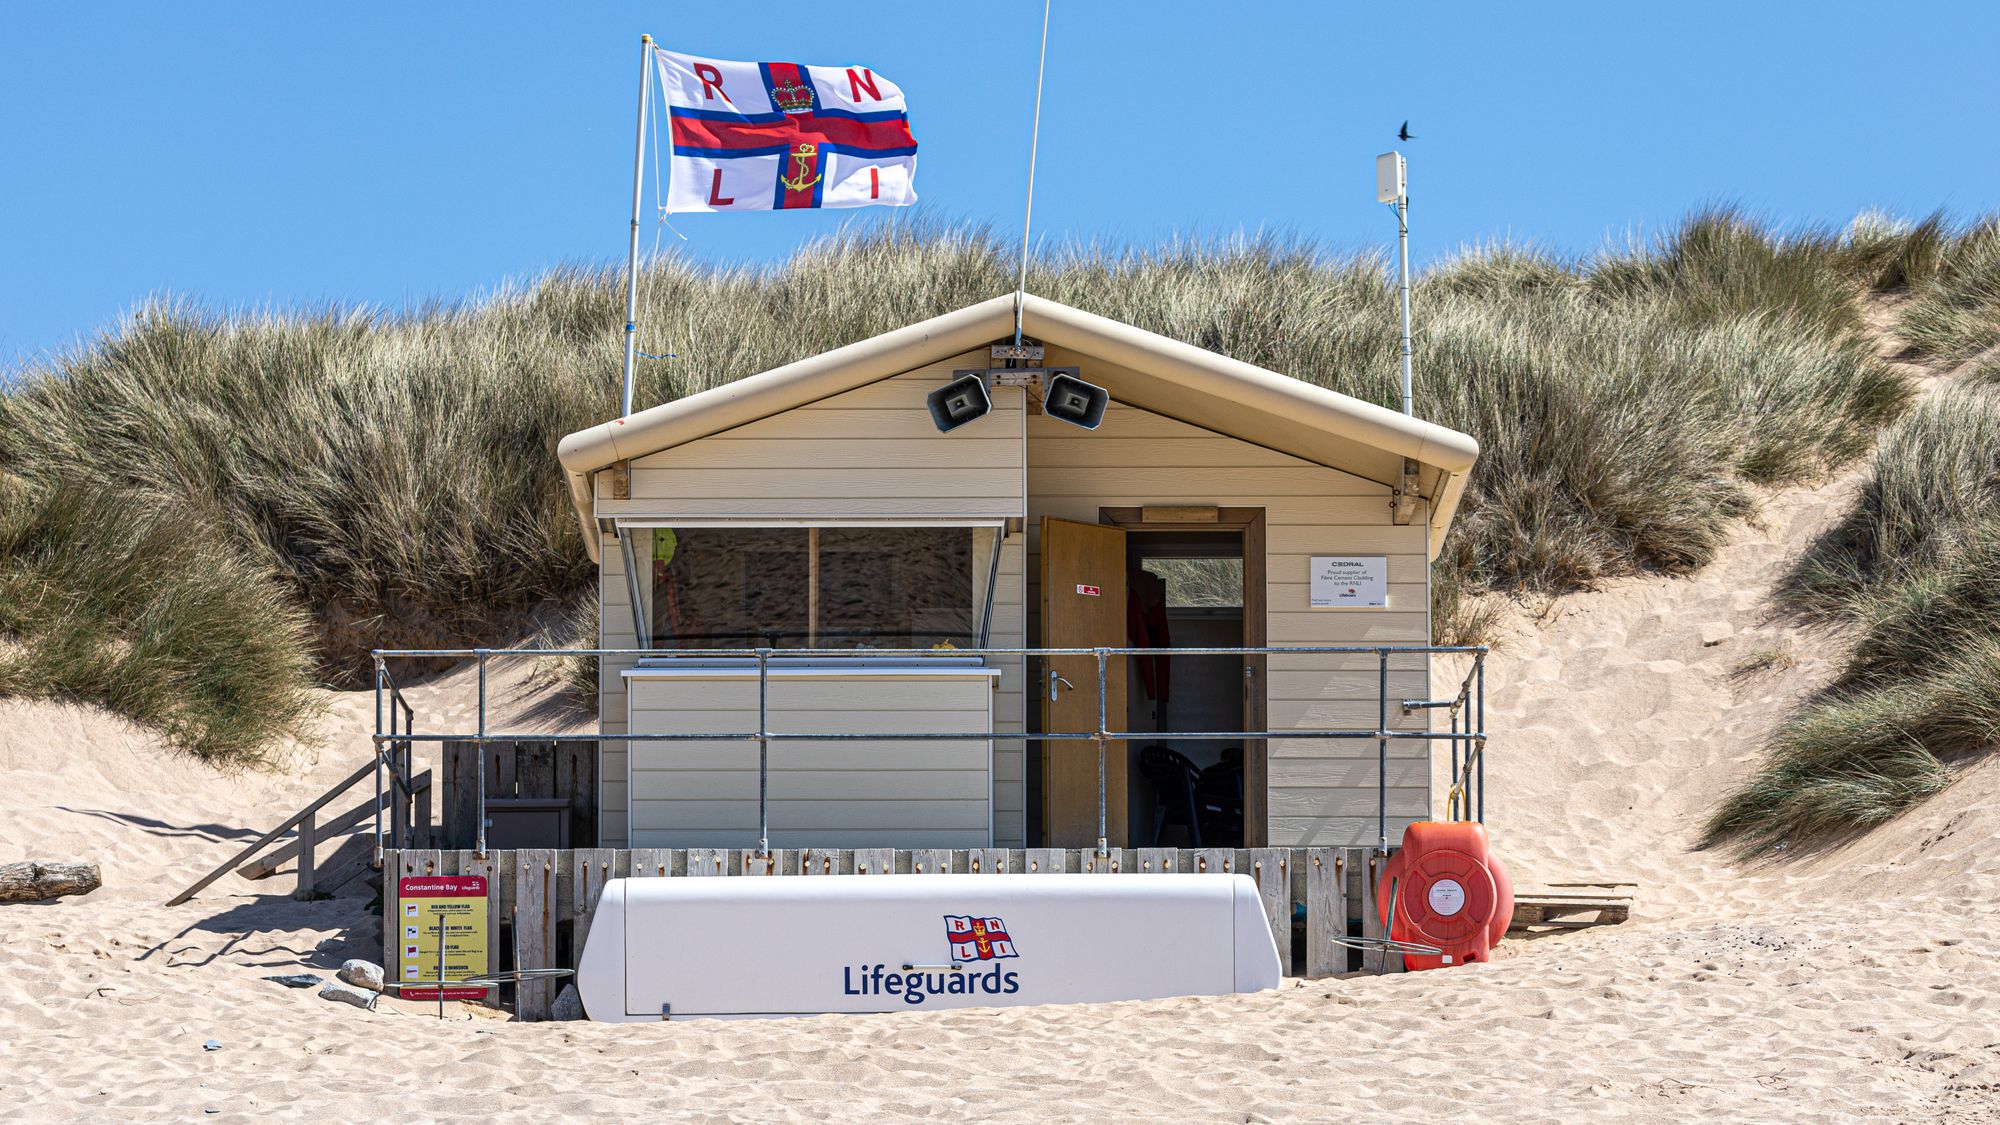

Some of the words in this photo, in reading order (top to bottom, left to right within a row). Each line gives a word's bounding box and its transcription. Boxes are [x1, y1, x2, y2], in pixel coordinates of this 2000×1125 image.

[693, 62, 732, 103] R
[846, 68, 882, 103] N
[708, 168, 735, 206] L
[870, 167, 879, 199] I
[954, 920, 963, 930] R
[989, 920, 1000, 930] N
[961, 946, 971, 958] L
[1000, 943, 1006, 954] I
[844, 962, 1020, 1005] Lifeguards
